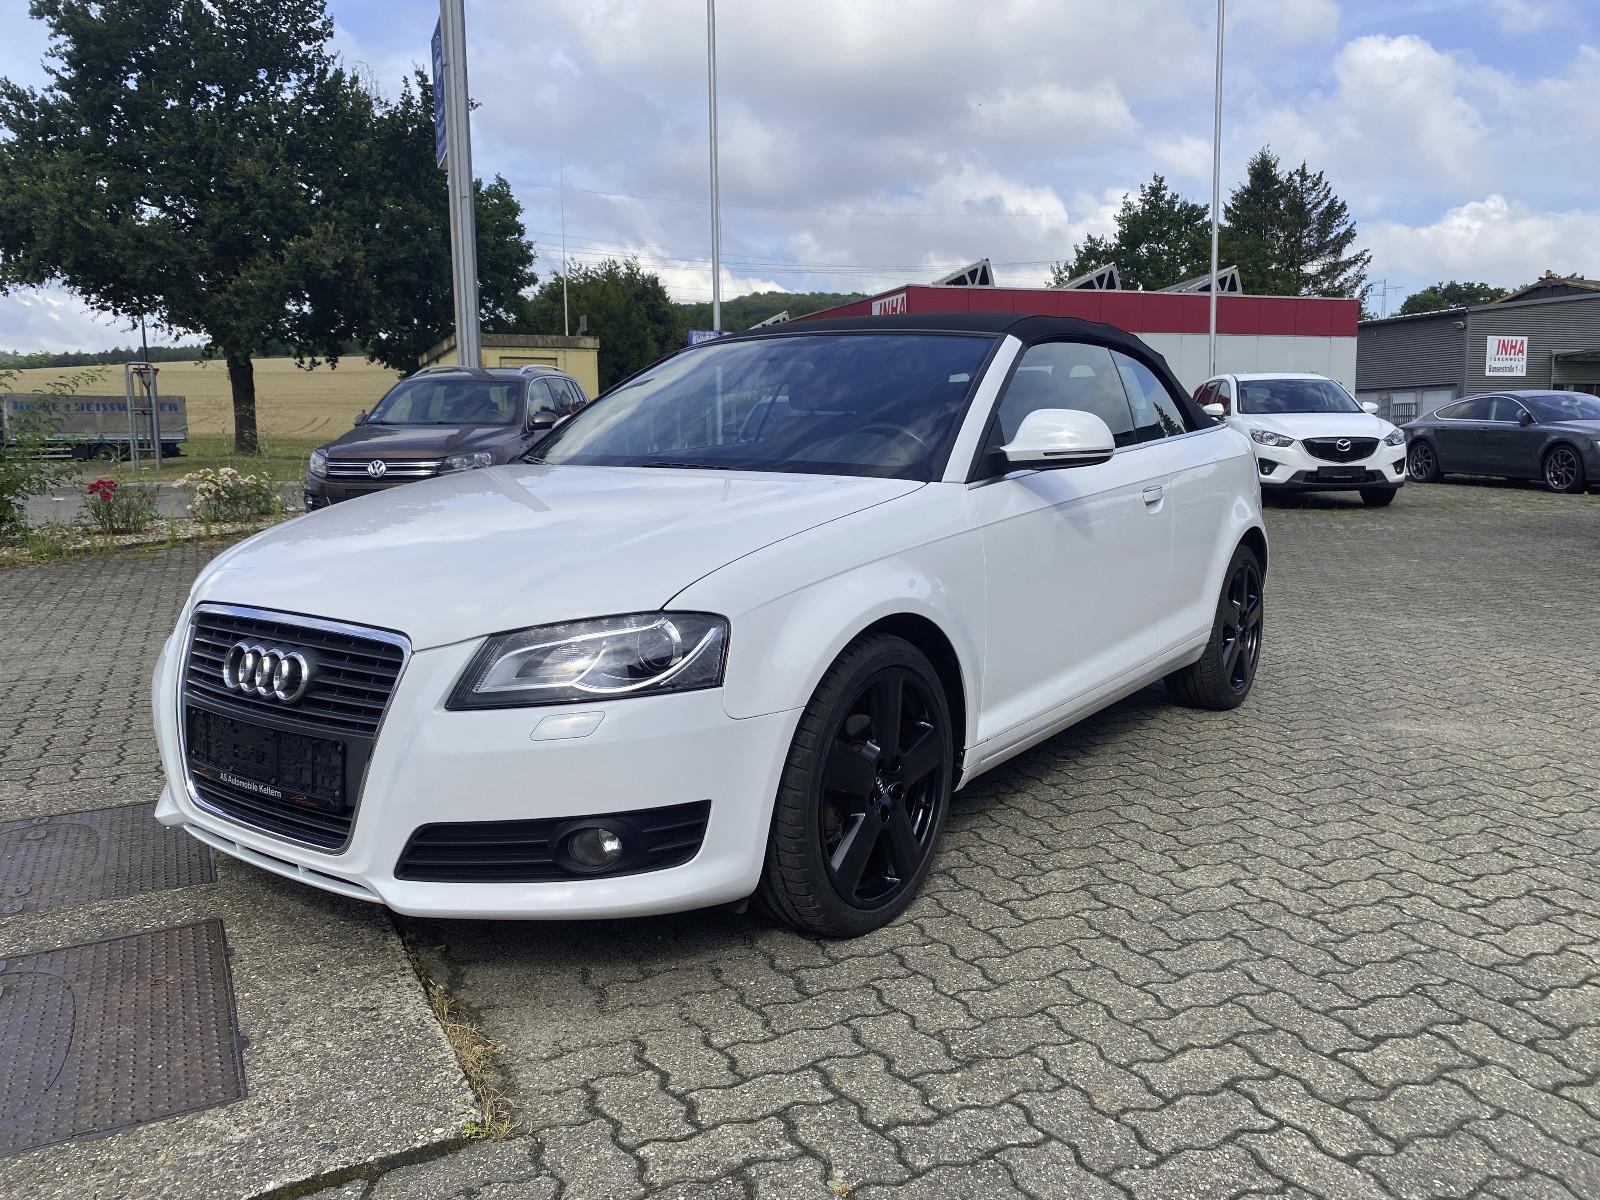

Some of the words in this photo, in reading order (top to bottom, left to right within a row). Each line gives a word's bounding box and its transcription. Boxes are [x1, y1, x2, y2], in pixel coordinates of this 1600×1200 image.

[880, 295, 906, 315] INHA
[1496, 339, 1525, 356] INHA
[228, 775, 258, 792] Automobile
[259, 784, 282, 798] Keltern
